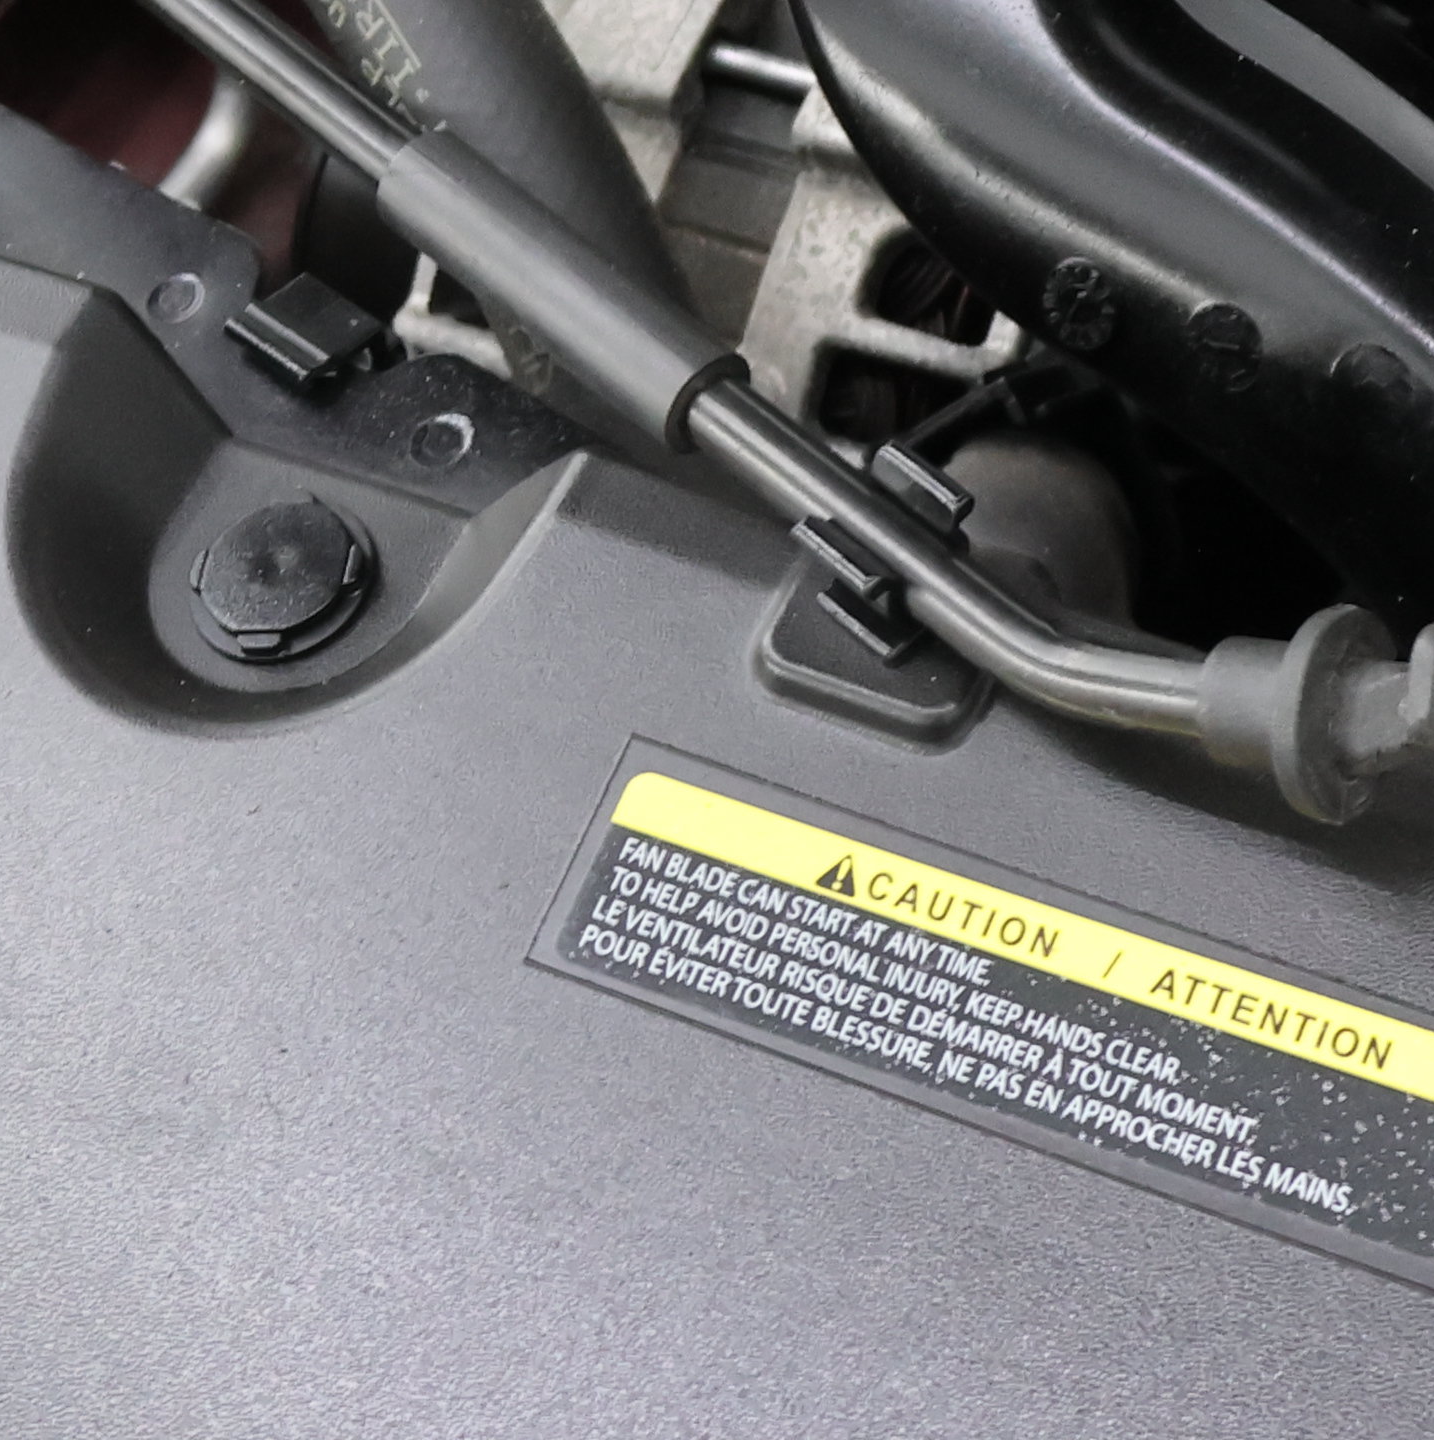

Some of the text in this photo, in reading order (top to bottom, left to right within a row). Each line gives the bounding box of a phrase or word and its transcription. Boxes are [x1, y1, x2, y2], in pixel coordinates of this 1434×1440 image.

[592, 894, 622, 927] LE
[622, 903, 781, 980] VENTILATEUR
[780, 954, 871, 1012] RISQUE
[869, 989, 908, 1025] DE
[907, 1002, 1044, 1074] DÉMARRER
[1041, 1046, 1066, 1081] À
[1067, 1057, 1139, 1102] TOUT
[610, 865, 1183, 1087] TO HELP AVOID PERSONAL INJURY, KEEP HANDS CLEAR.
[619, 836, 666, 874] FAN
[664, 852, 740, 901] BLADE
[739, 878, 789, 916] CAN
[787, 894, 856, 938] START
[858, 918, 887, 948] AT
[887, 929, 941, 973] ANY
[867, 871, 1394, 1071] CAUTION / ATTENTION
[578, 923, 650, 966] POUR
[649, 945, 739, 999] ÉVITER
[731, 977, 811, 1026] TOUTE
[811, 1006, 933, 1073] BLESSURE,
[937, 1050, 974, 1084] NE
[974, 1062, 1025, 1102] PAS
[1024, 1078, 1066, 1115] EN
[1062, 1093, 1218, 1168] APPROCHER
[1216, 1142, 1264, 1185] LES
